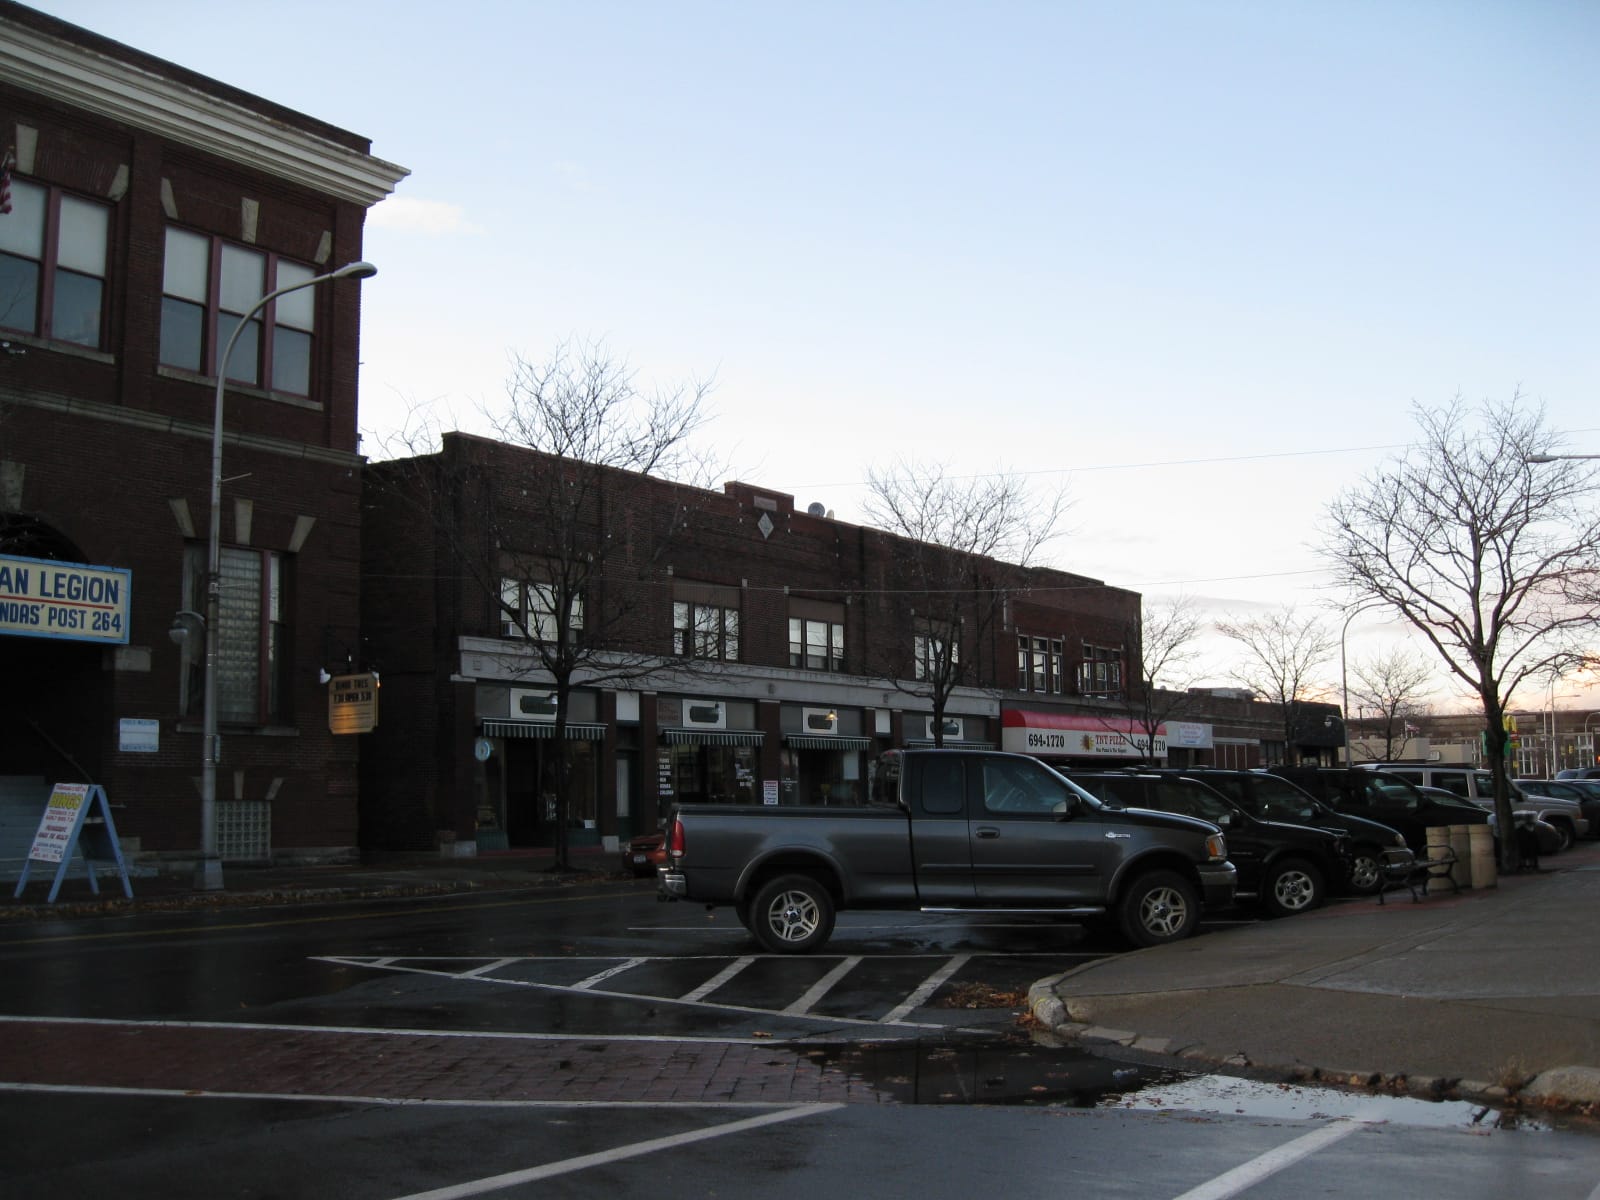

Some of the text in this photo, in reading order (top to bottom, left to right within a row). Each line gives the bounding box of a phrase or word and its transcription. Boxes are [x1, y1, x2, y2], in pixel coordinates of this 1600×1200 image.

[40, 571, 119, 605] LEGION
[48, 606, 87, 629] POST
[92, 610, 121, 633] 264
[1028, 733, 1065, 748] 694-1770
[1095, 734, 1108, 745] TNT
[1137, 738, 1166, 751] 694770
